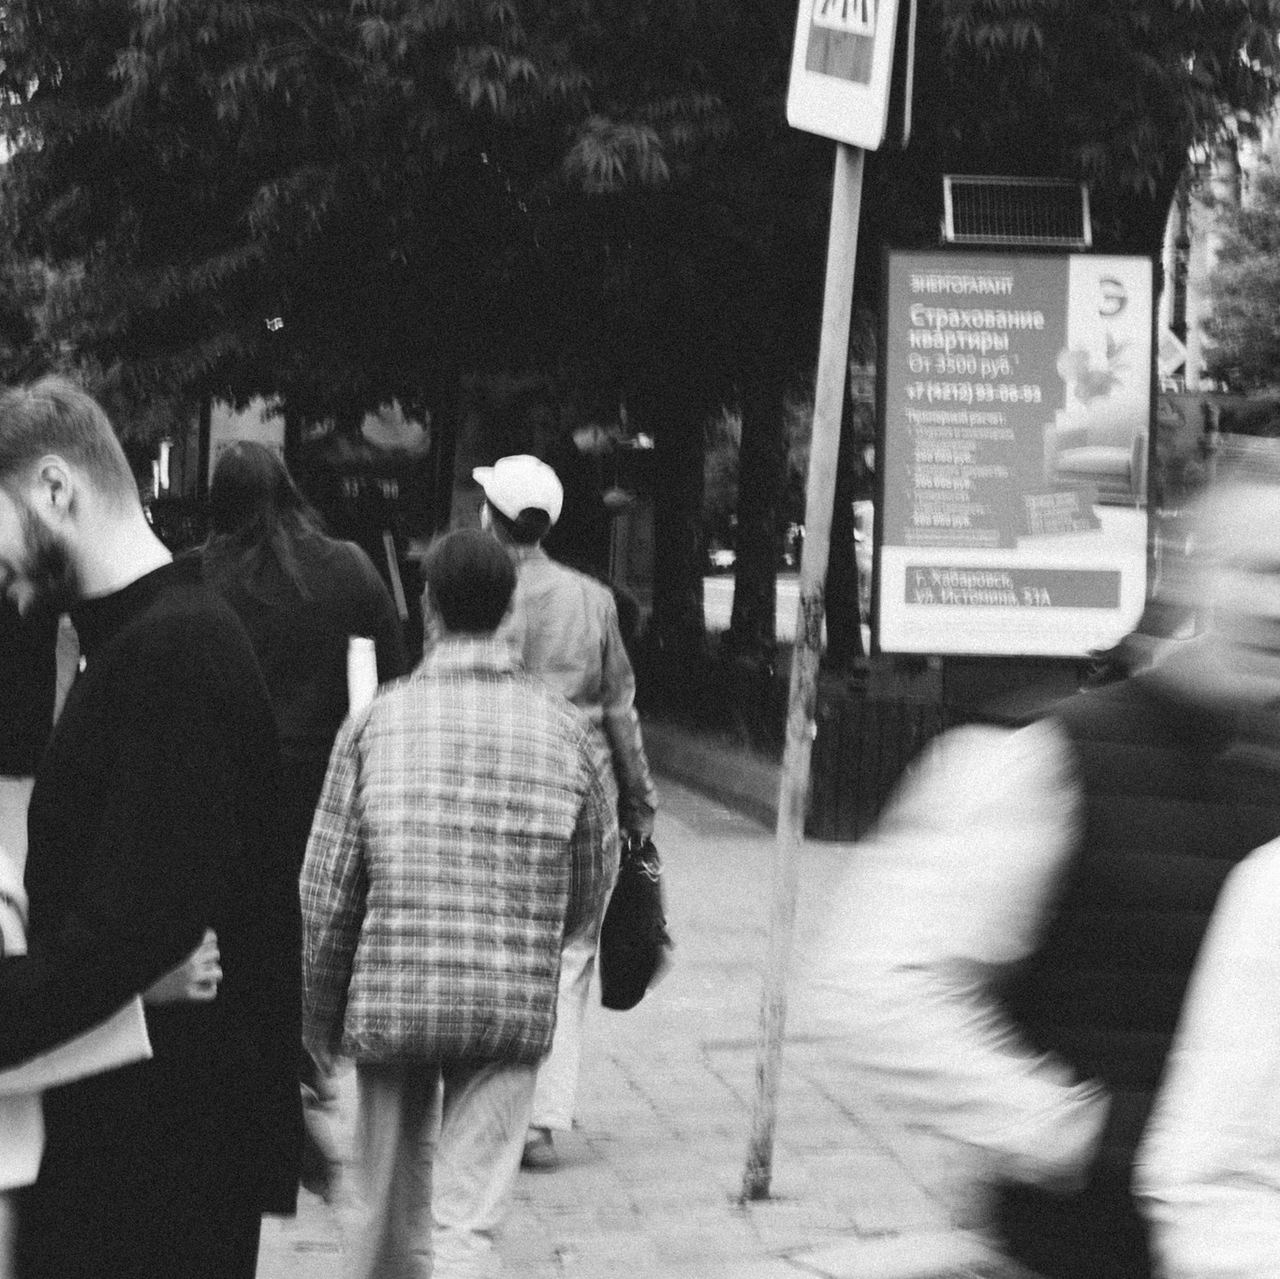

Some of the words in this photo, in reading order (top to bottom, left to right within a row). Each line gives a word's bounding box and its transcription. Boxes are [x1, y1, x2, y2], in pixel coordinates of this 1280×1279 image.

[910, 275, 1014, 294] ЭНЕРГОГАРАНТ
[910, 304, 1045, 331] Страхование
[909, 329, 1009, 355] квартиры
[909, 354, 931, 373] От
[934, 354, 977, 374] 3500
[906, 382, 925, 400] +7
[926, 381, 973, 404] (4212)
[931, 569, 1014, 589] Хабаровск,
